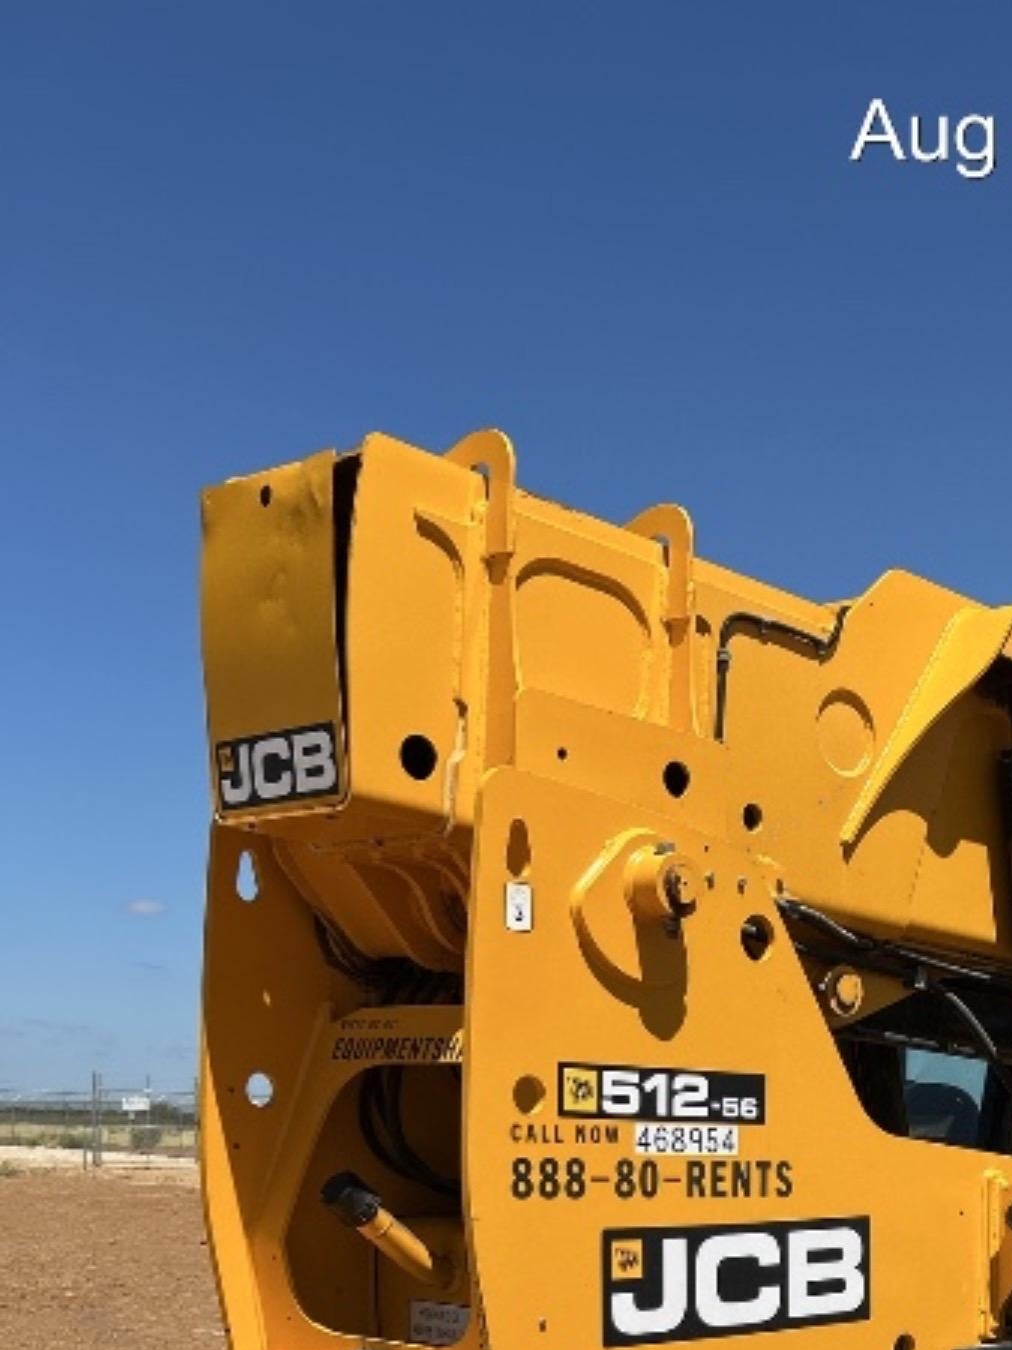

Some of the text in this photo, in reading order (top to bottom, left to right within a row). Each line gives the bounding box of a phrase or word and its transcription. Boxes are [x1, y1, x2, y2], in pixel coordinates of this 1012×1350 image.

[220, 729, 337, 804] JCB
[601, 1070, 758, 1119] 512-56
[510, 1124, 619, 1144] CALL NOW
[637, 1126, 735, 1153] 468954
[511, 1156, 793, 1200] 888-80-RENTS
[611, 1226, 865, 1336] JCB
